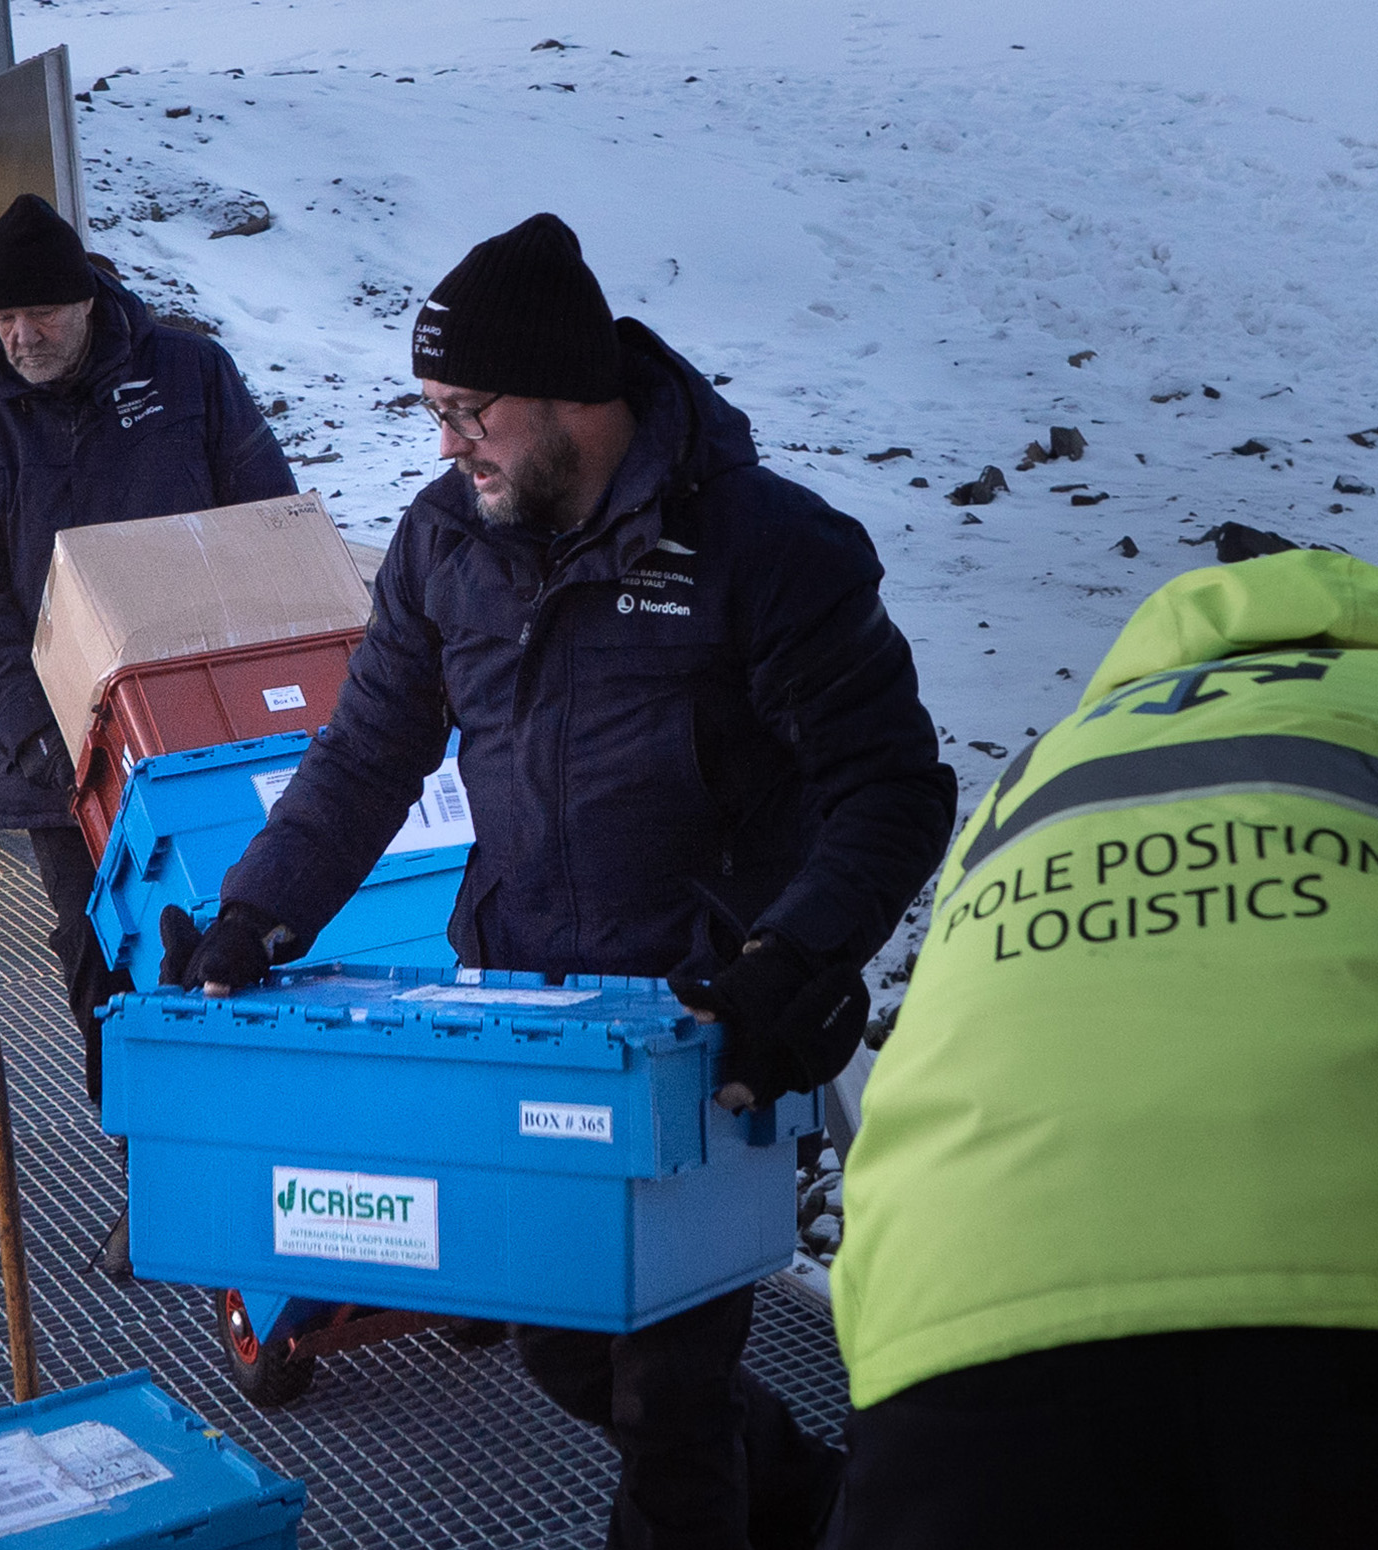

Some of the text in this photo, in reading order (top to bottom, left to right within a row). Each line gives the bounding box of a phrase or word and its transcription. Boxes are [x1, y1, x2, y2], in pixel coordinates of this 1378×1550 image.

[642, 579, 667, 588] VAULT
[663, 571, 695, 585] GLOBAL
[640, 598, 691, 616] NordGen
[944, 850, 1075, 944] POLE
[995, 873, 1330, 962] LOGISTICS
[524, 1112, 605, 1134] BOX # 365
[301, 1184, 415, 1222] ICRISAT
[282, 1240, 321, 1251] INSTITUTE
[290, 1228, 353, 1243] INTERNATIONAL
[385, 1236, 427, 1249] RESEARCH
